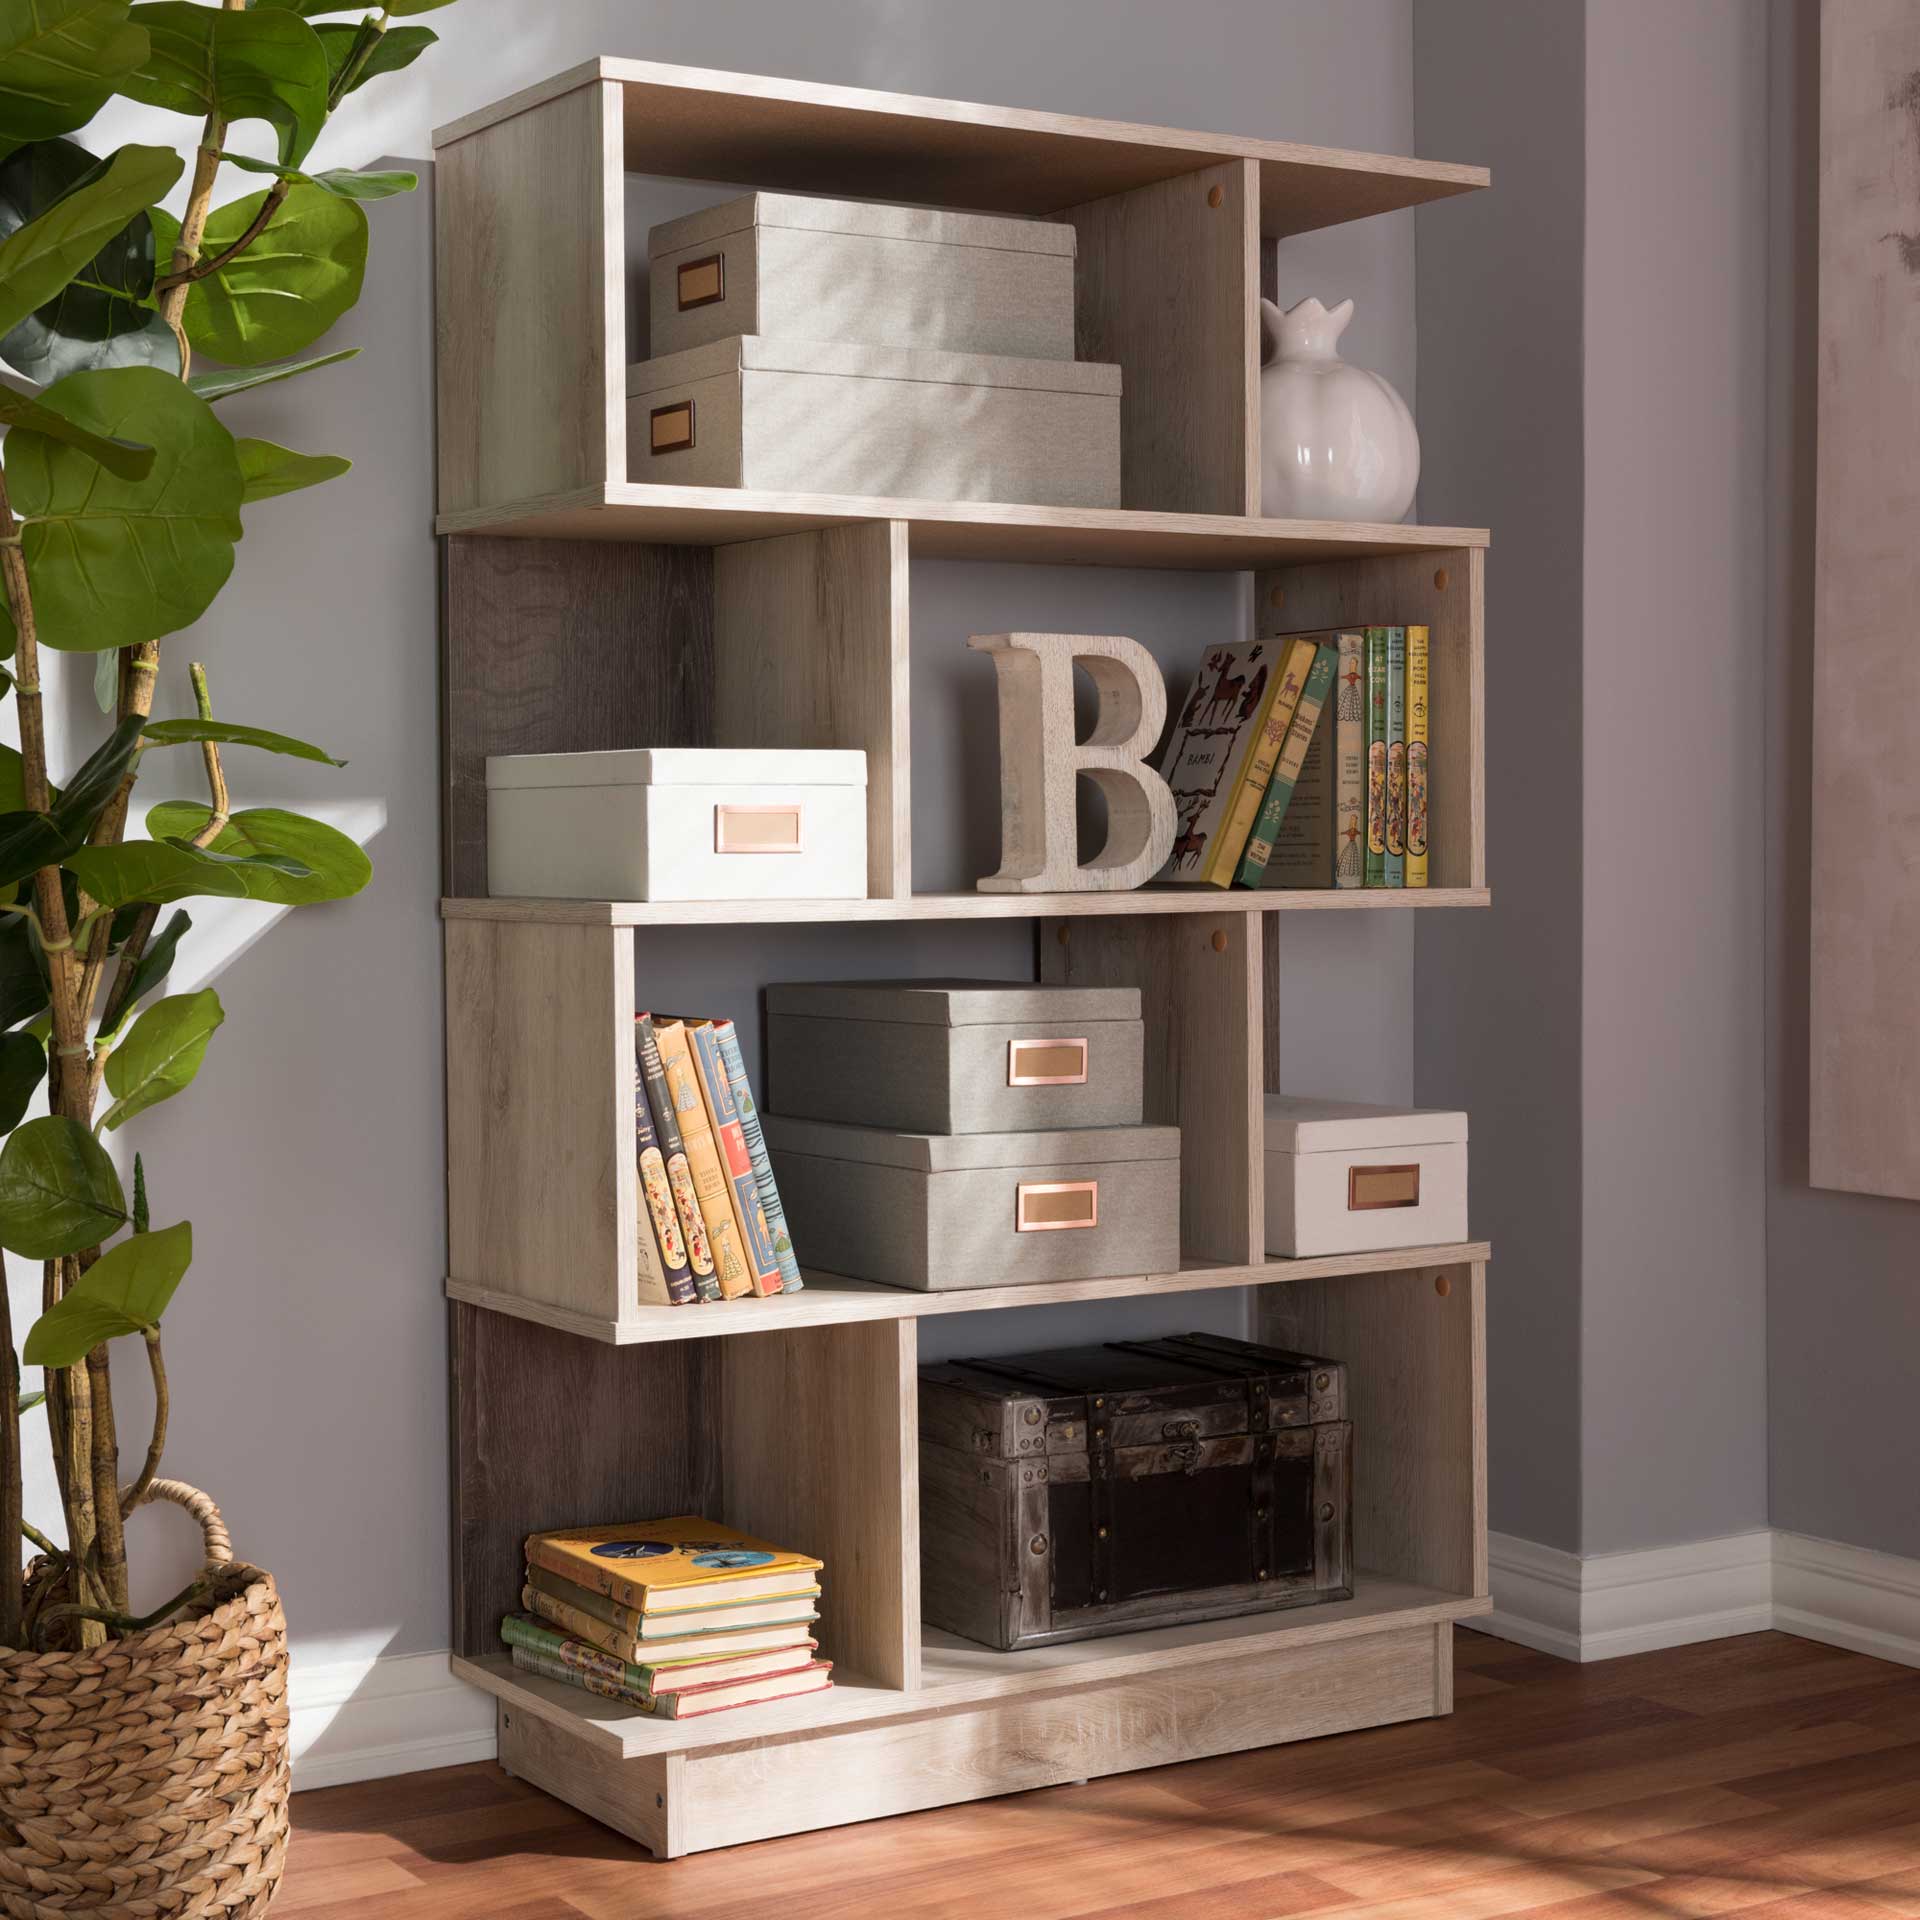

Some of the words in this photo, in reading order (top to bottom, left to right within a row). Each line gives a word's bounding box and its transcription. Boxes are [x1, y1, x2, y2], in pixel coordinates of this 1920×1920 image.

[1000, 632, 1178, 894] B
[1187, 752, 1216, 766] BAMBI
[742, 1114, 764, 1149] THIS
[750, 1151, 768, 1168] IS
[755, 1168, 774, 1189] MY
[761, 1191, 784, 1224] LIFE
